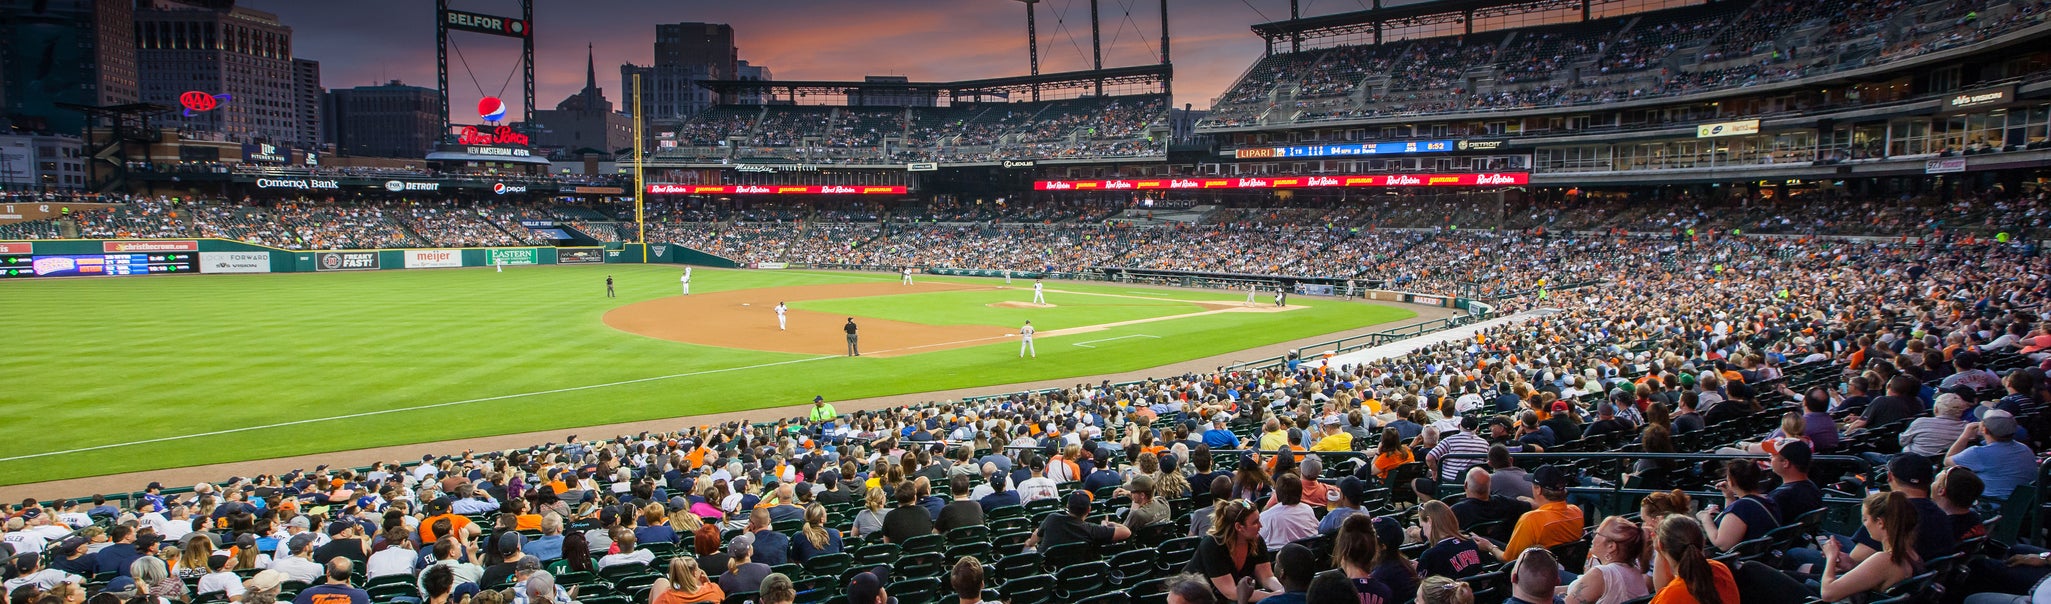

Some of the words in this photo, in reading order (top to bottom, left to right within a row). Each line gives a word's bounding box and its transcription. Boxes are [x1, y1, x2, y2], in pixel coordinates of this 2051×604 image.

[448, 12, 502, 30] BELFOR
[184, 93, 213, 110] AAA
[1971, 92, 2003, 102] VISION
[458, 126, 492, 145] Pepsi
[467, 147, 479, 155] NEW
[480, 147, 511, 156] AMSTERDAM
[1241, 149, 1271, 158] LIPARI
[311, 180, 339, 189] Bank
[1170, 179, 1182, 188] Red
[1182, 179, 1198, 188] Robin
[1238, 178, 1251, 187] Red
[1250, 178, 1267, 187] Robin
[1307, 177, 1321, 186] Red
[1320, 177, 1339, 186] Robin
[1386, 175, 1401, 185] Red
[1400, 175, 1421, 185] Robin
[1476, 174, 1493, 184] Red
[1491, 174, 1515, 184] Robin
[405, 182, 439, 191] DETROIT
[652, 185, 667, 193] Red
[666, 185, 687, 193] Robin
[735, 185, 750, 193] Red
[749, 185, 770, 193] Robin
[6, 205, 15, 213] 11
[39, 205, 49, 213] 42
[417, 250, 450, 262] meijer
[492, 249, 532, 259] EASTERN
[343, 259, 374, 267] FAST!
